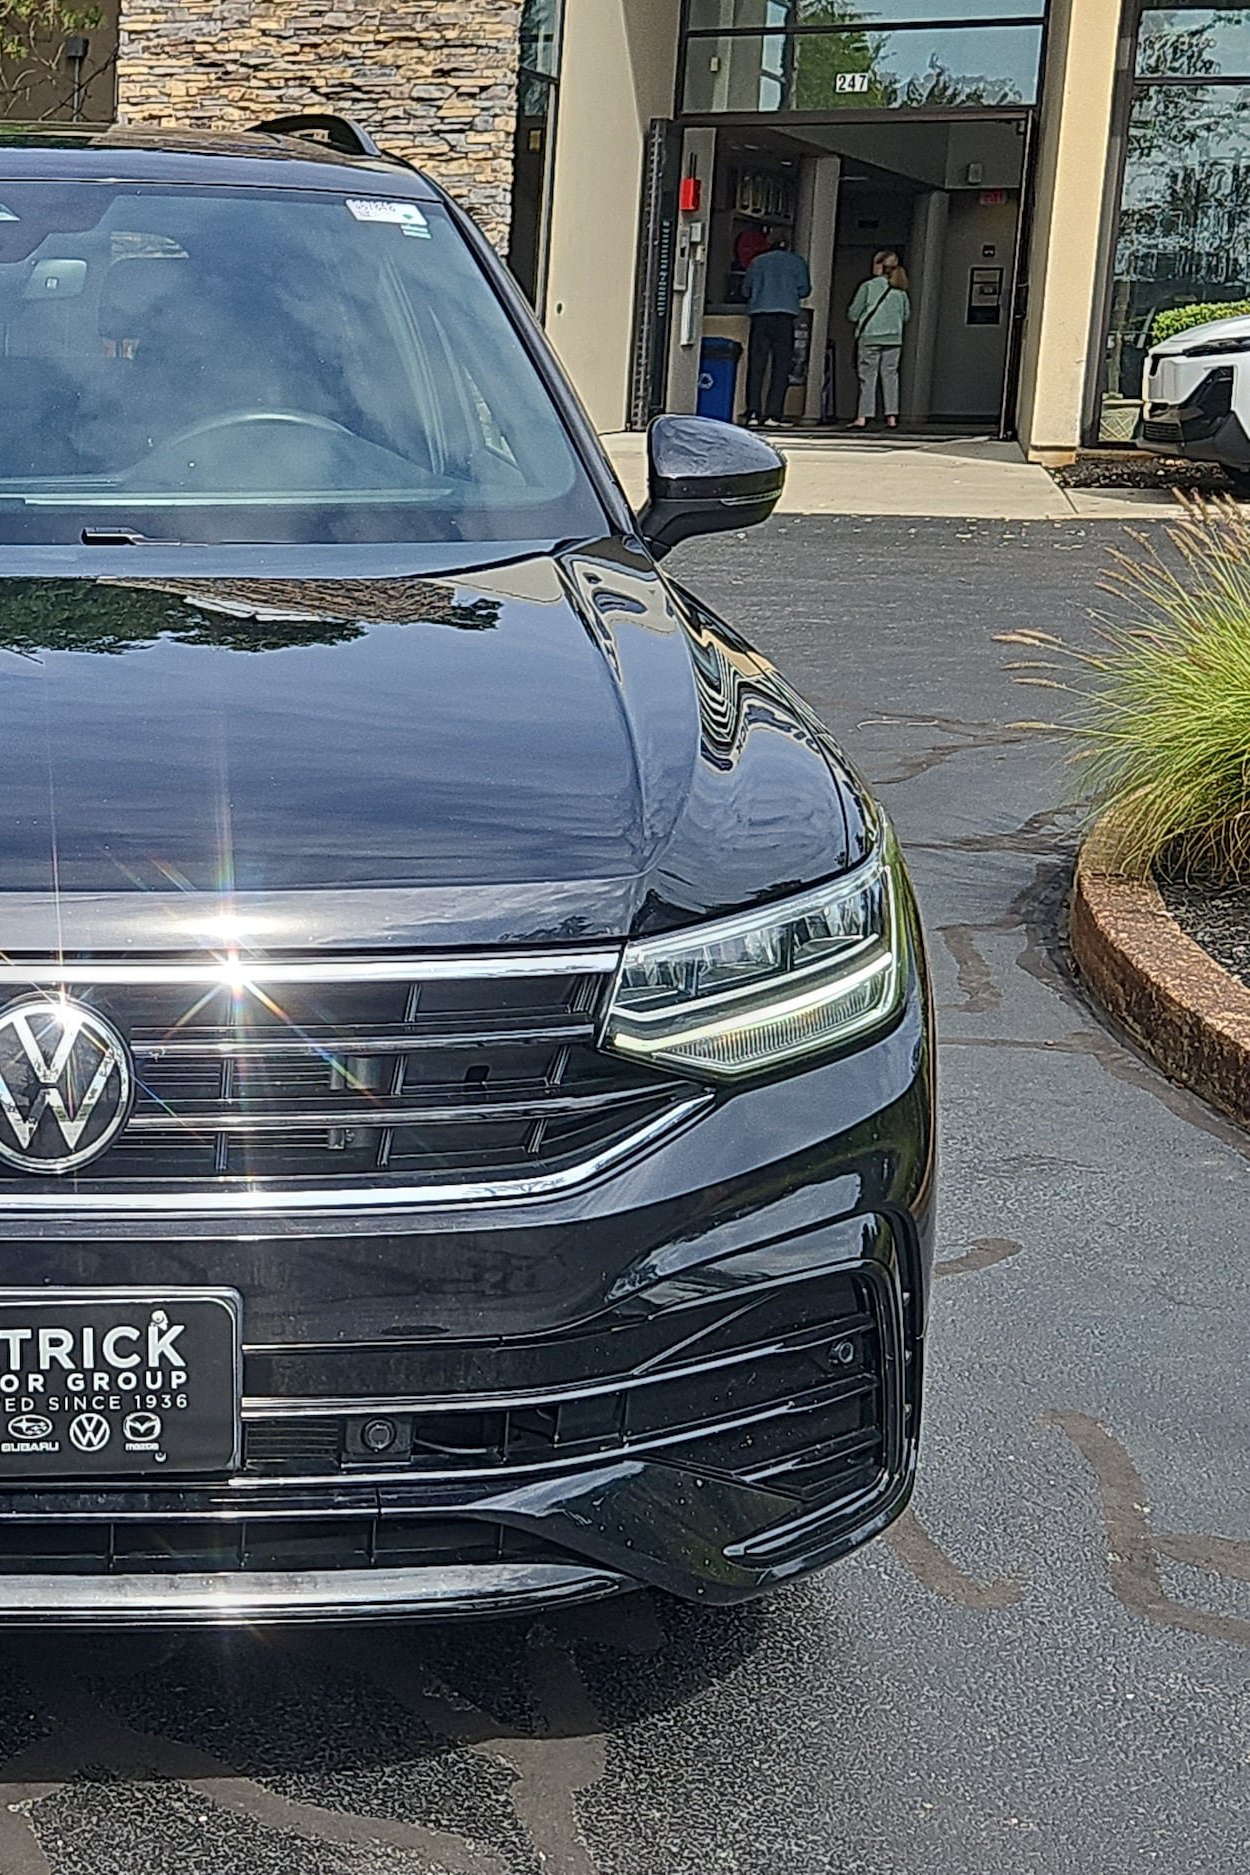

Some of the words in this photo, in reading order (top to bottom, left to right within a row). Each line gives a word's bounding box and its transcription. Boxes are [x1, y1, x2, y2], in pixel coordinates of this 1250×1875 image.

[838, 74, 867, 91] 247
[66, 1371, 188, 1392] GROUP
[48, 1395, 122, 1411] SINCE
[134, 1394, 188, 1409] 1936
[0, 1442, 59, 1452] SUBARU
